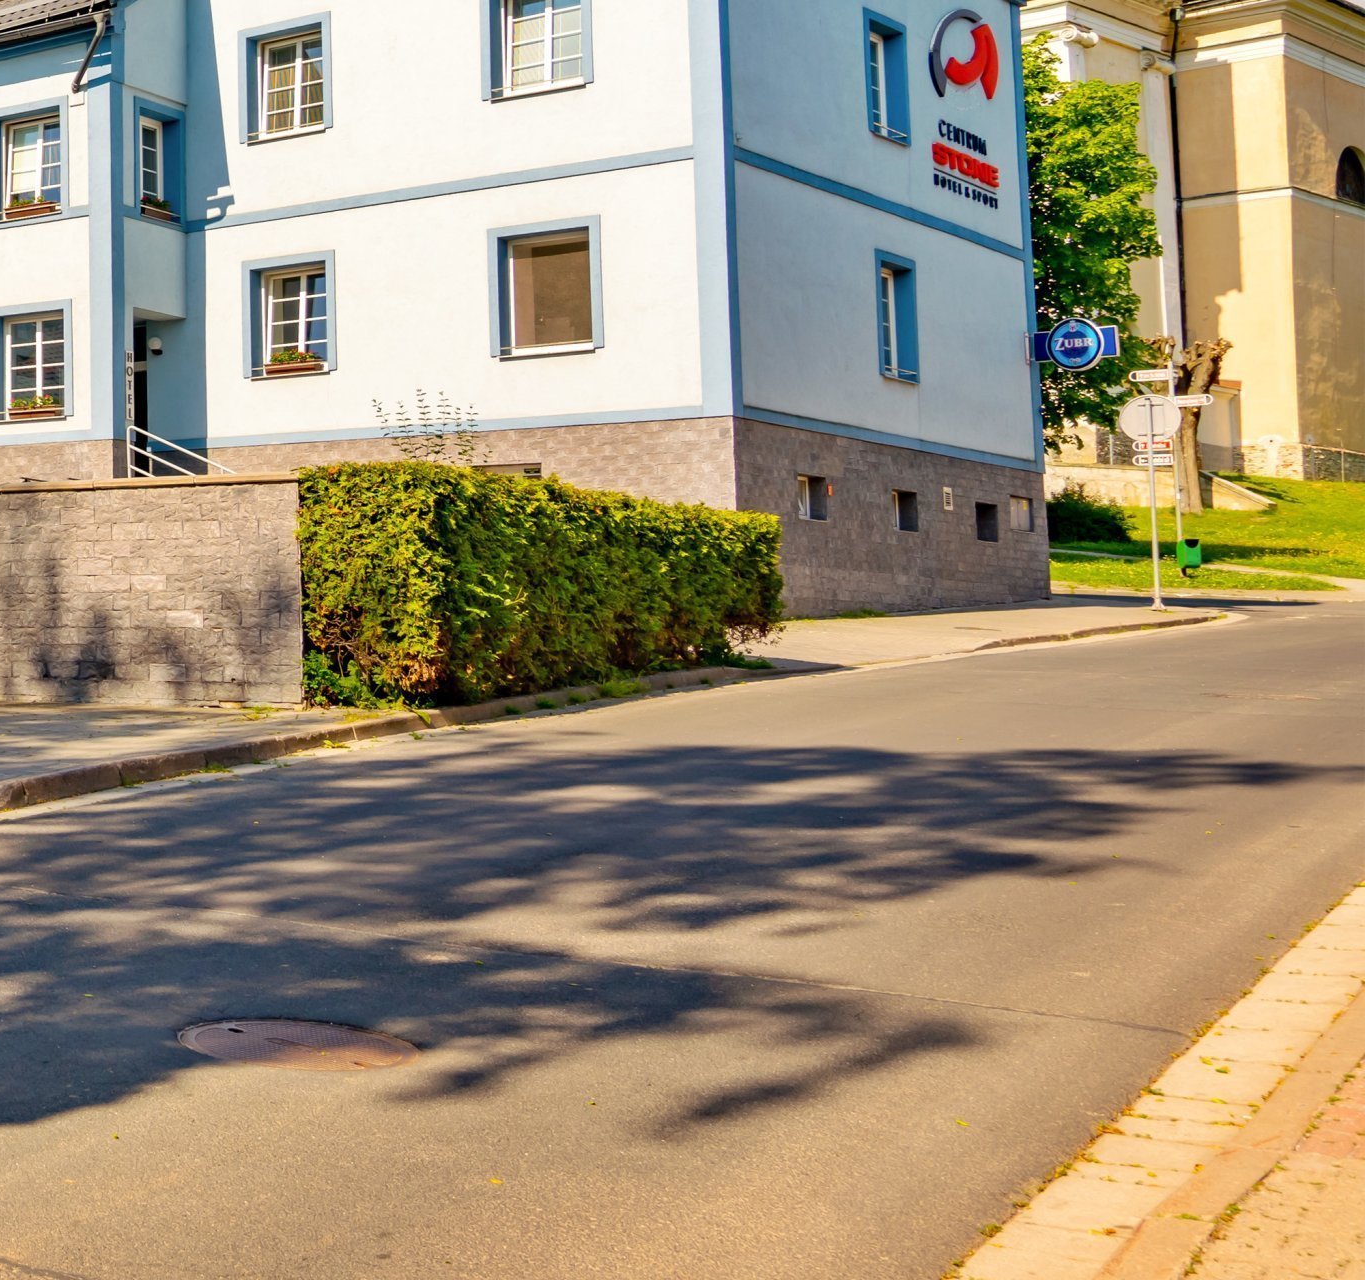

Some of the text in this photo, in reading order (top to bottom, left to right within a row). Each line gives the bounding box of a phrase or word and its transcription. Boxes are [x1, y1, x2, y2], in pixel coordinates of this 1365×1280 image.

[938, 118, 987, 156] CENTRUM
[932, 141, 1000, 188] STONE
[933, 173, 998, 209] HOTEL & SPORT
[1054, 337, 1094, 351] ZUBR
